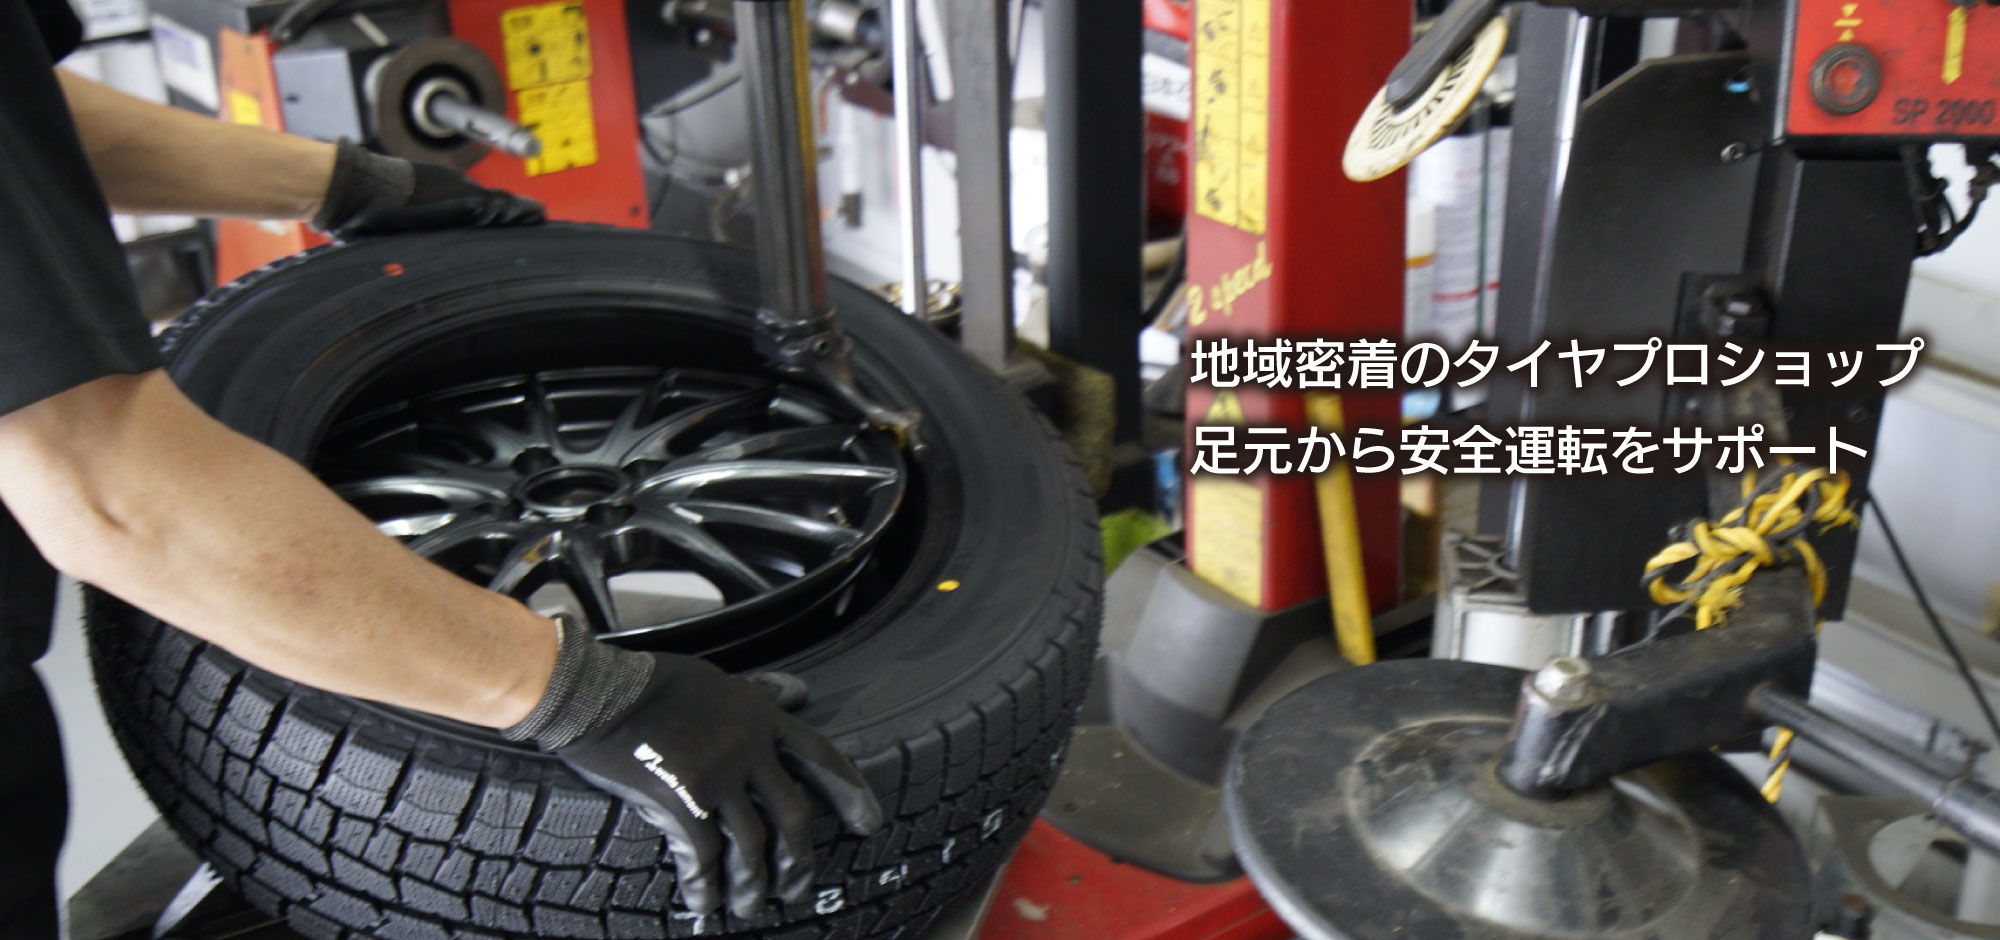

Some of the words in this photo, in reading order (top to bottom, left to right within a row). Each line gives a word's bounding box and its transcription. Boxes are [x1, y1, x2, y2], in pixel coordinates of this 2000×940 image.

[1892, 97, 1929, 125] SP
[1936, 98, 1996, 126] 2000
[1187, 285, 1208, 328] 2
